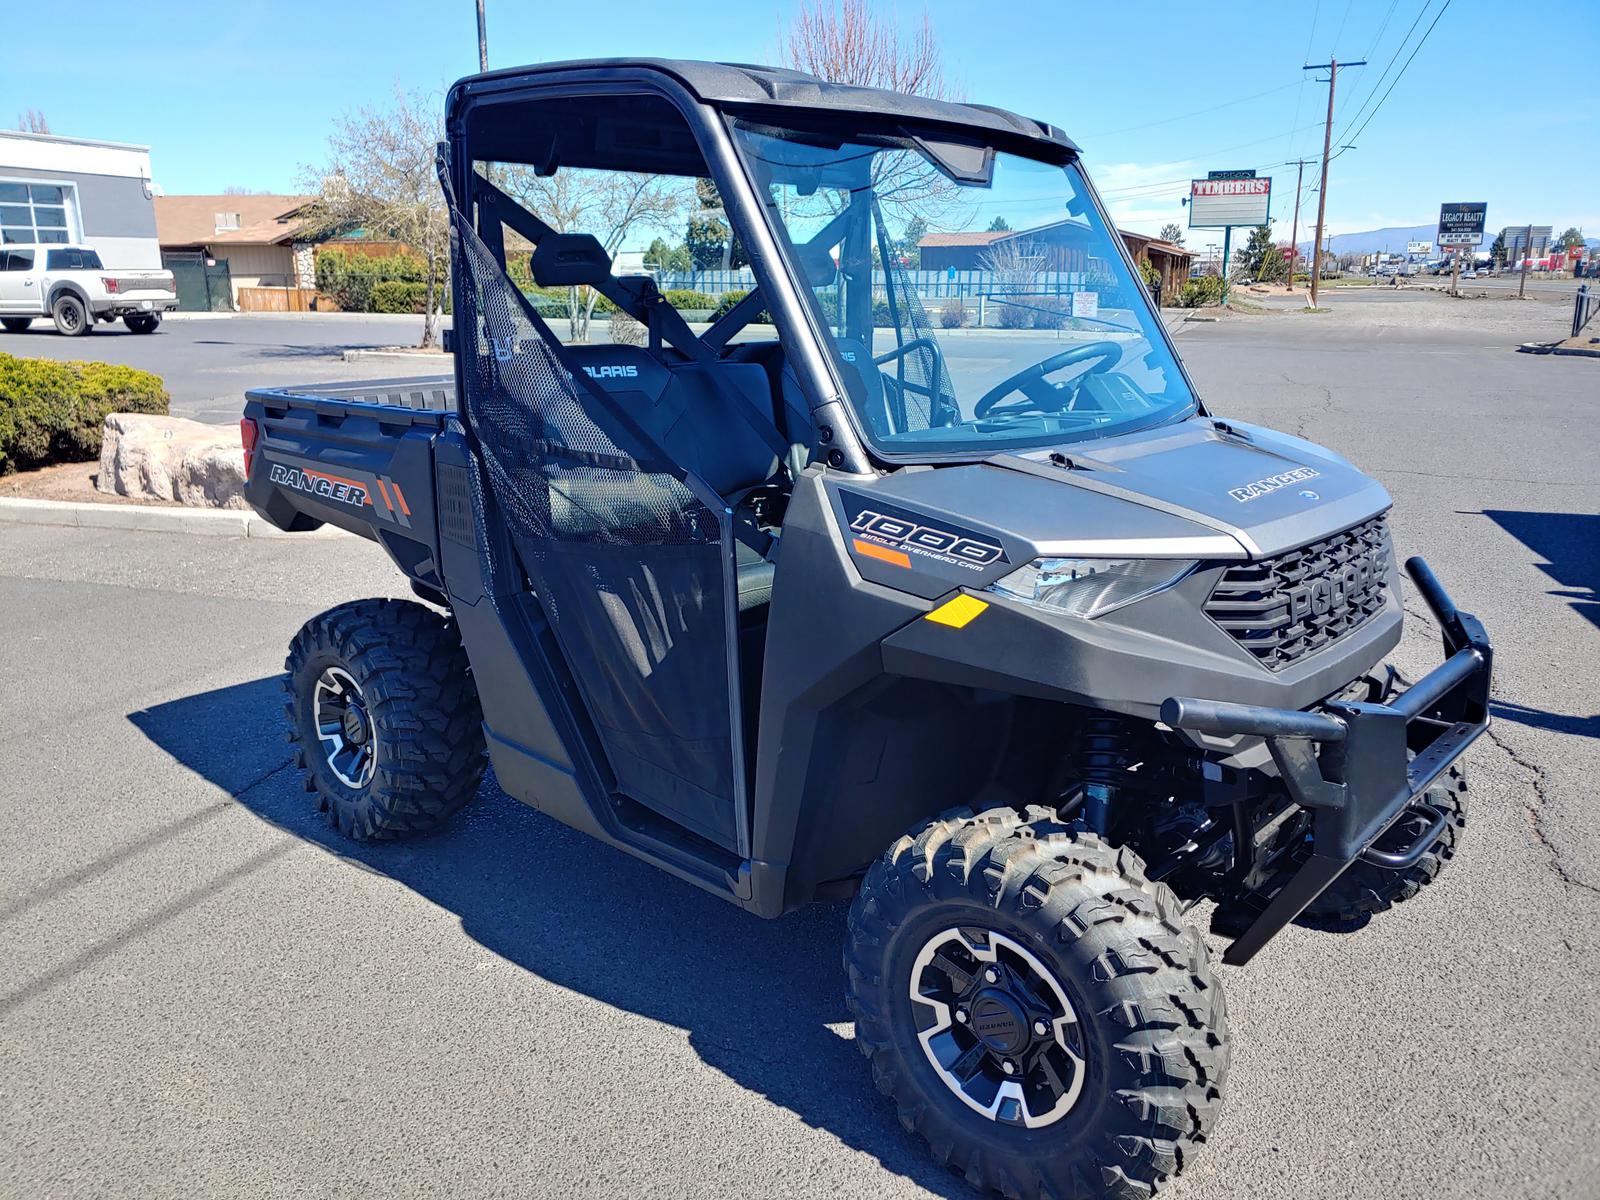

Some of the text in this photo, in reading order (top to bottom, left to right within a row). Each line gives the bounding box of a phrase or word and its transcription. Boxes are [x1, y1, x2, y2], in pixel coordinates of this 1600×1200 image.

[1193, 180, 1269, 195] TIMBERS
[1442, 212, 1484, 222] LEGACY REALTY
[270, 464, 367, 507] RANGER
[1228, 467, 1320, 502] RANGER
[850, 510, 1003, 565] 1000
[860, 533, 985, 572] SINGLE OVERHEAD CAM
[1291, 548, 1389, 626] POLARIS
